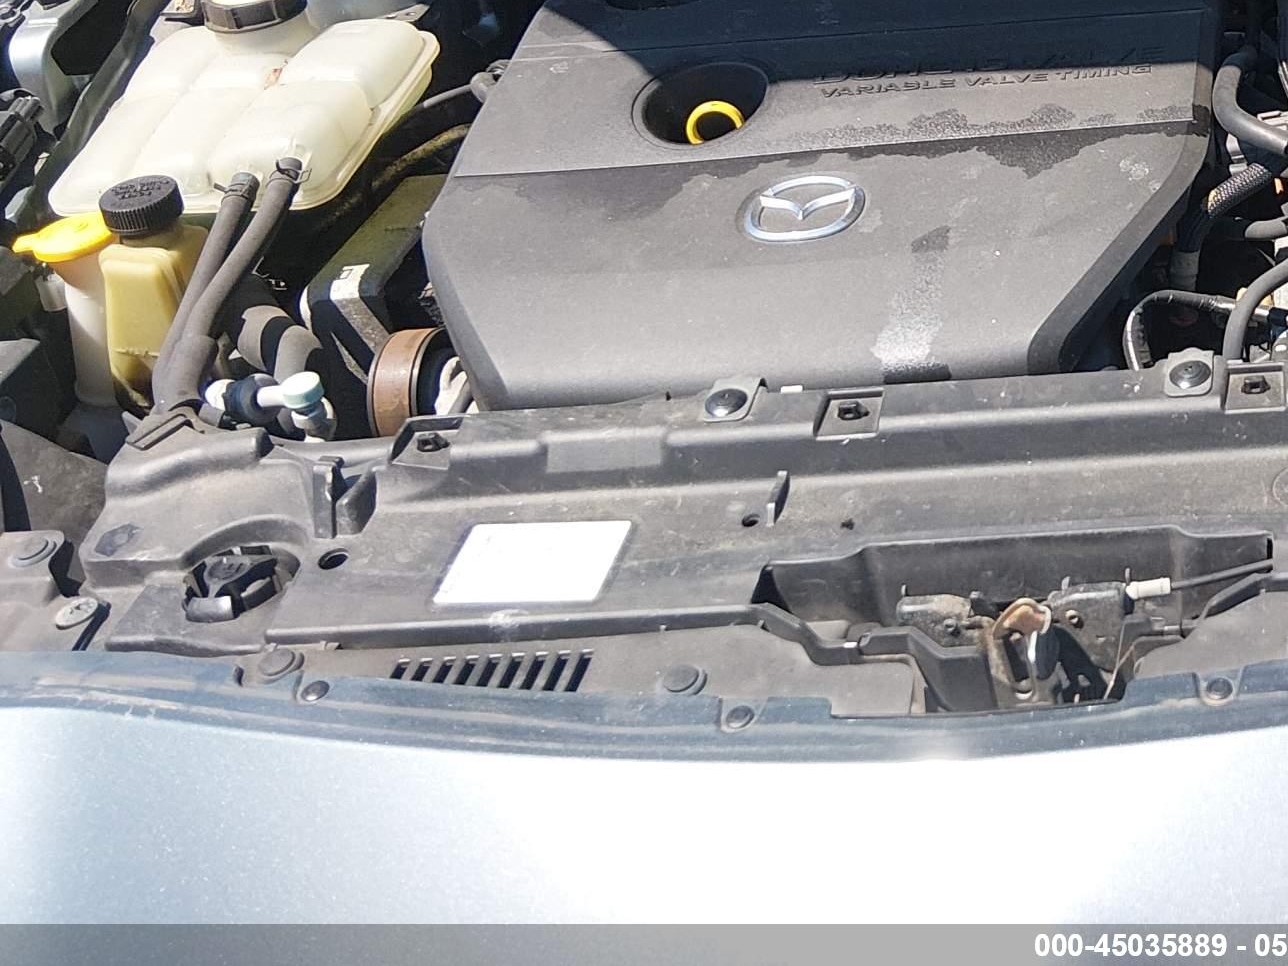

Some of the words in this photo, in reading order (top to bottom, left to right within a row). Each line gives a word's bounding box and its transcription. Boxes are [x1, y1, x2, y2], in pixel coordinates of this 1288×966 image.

[819, 78, 956, 98] VARIABLE
[965, 72, 1050, 88] VALVE
[1056, 64, 1153, 81] TIMING
